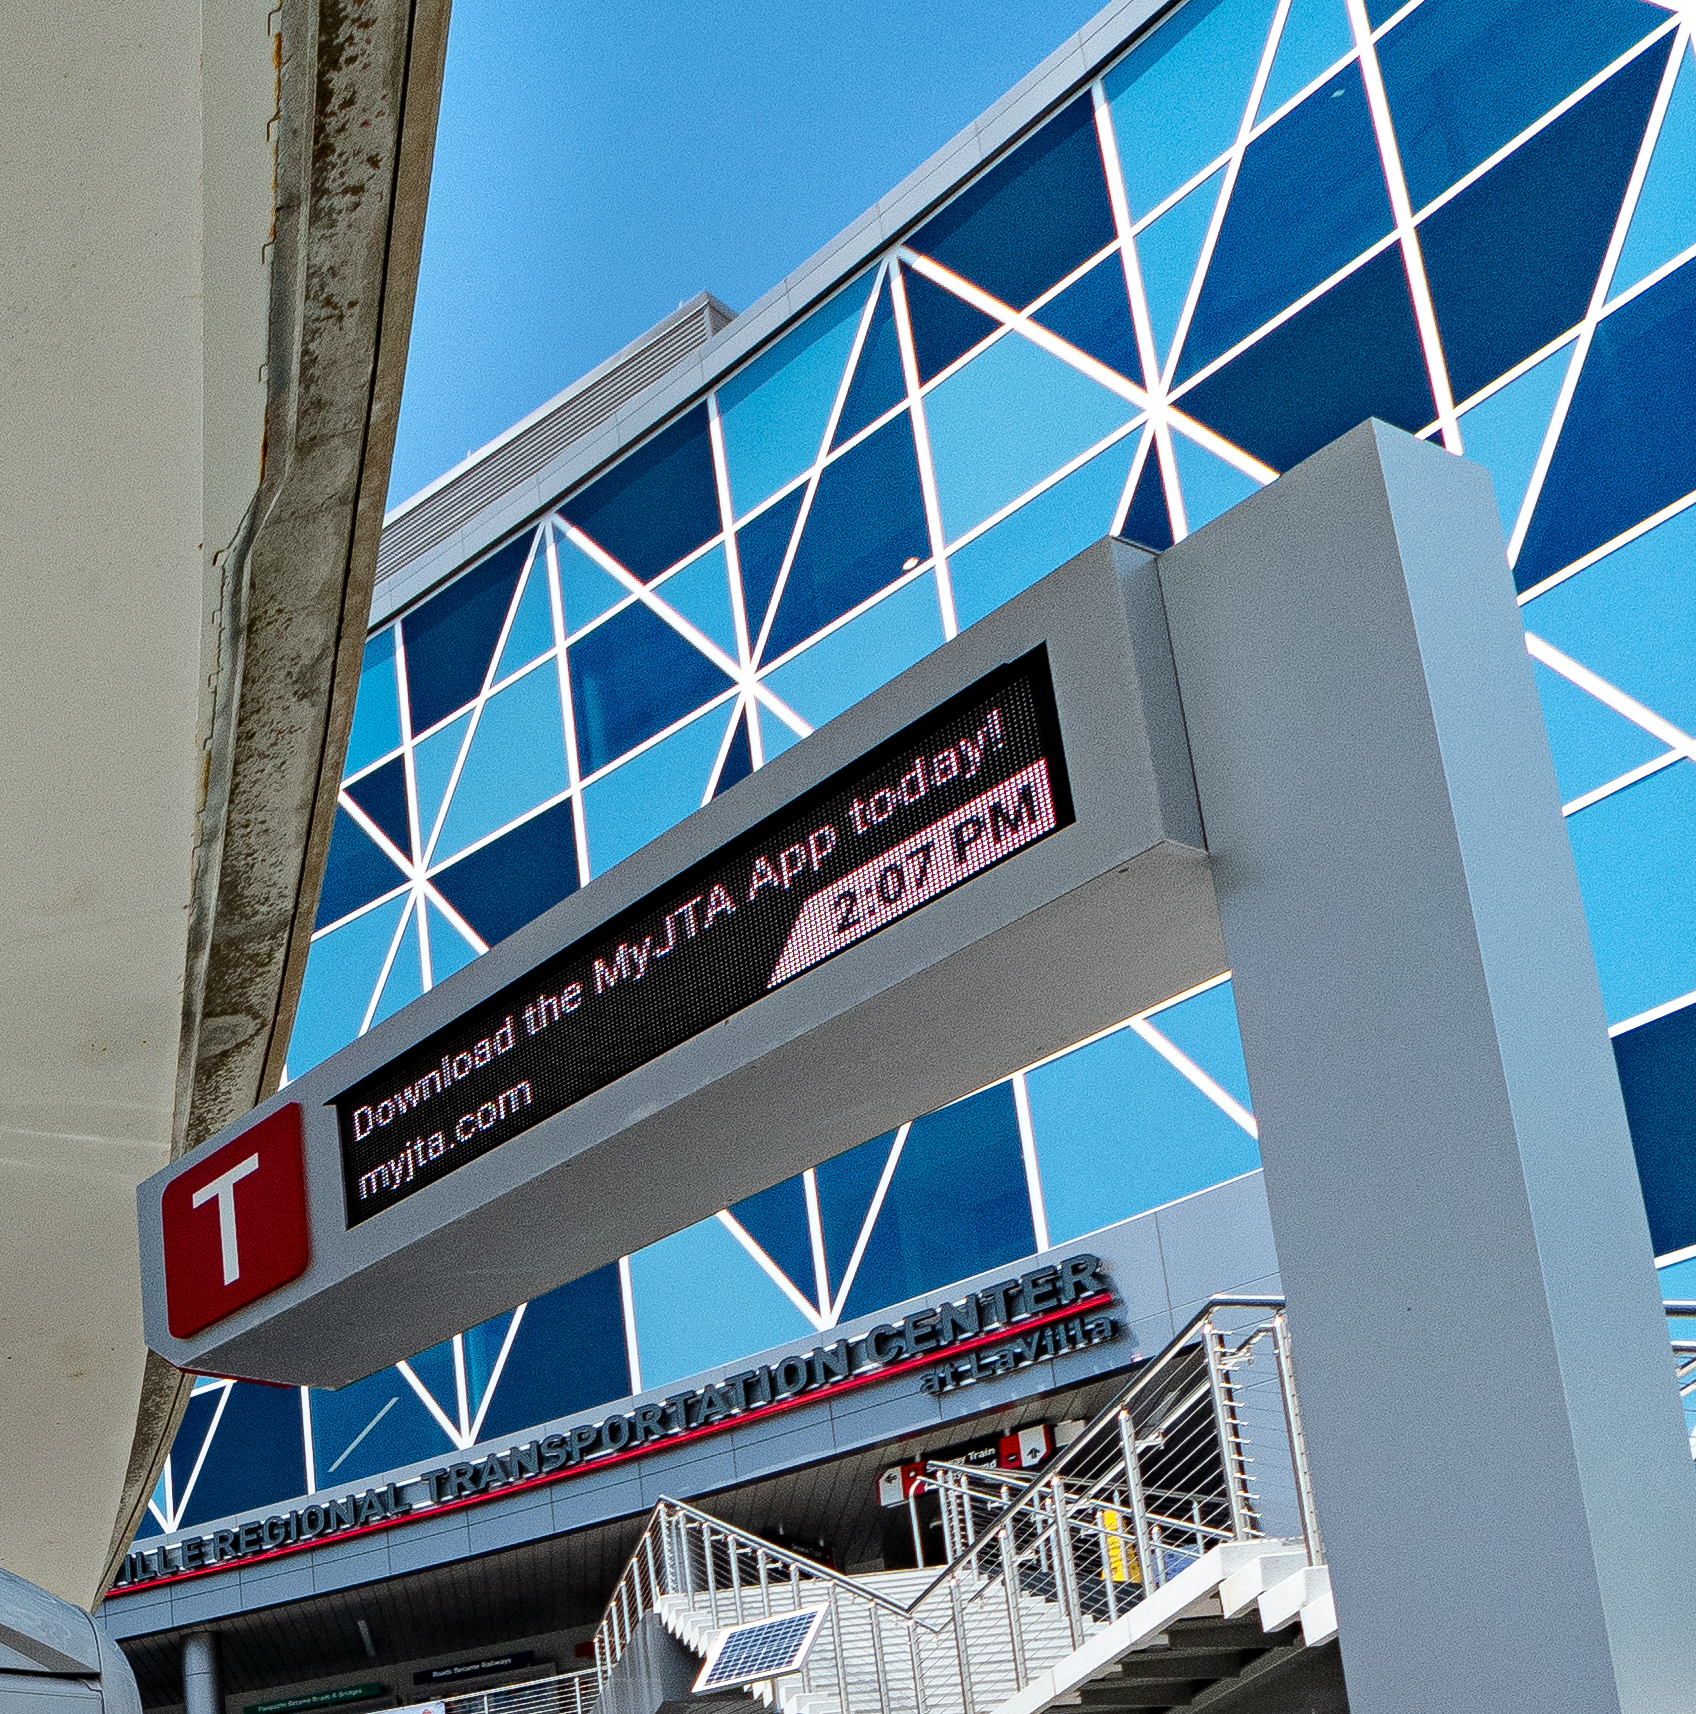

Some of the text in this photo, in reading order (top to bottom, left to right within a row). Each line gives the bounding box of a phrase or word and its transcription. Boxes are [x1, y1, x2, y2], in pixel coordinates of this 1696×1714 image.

[835, 783, 1038, 931] 2:07 PM
[353, 708, 1005, 1142] Download the MyJTA App today!
[359, 1080, 534, 1200] myjta.com
[192, 1152, 259, 1286] T
[123, 1253, 1105, 1582] ILLE REGIONAL TRANSPORTATION CENTER
[920, 1314, 1117, 1395] at LaVilla
[968, 1447, 996, 1462] Train
